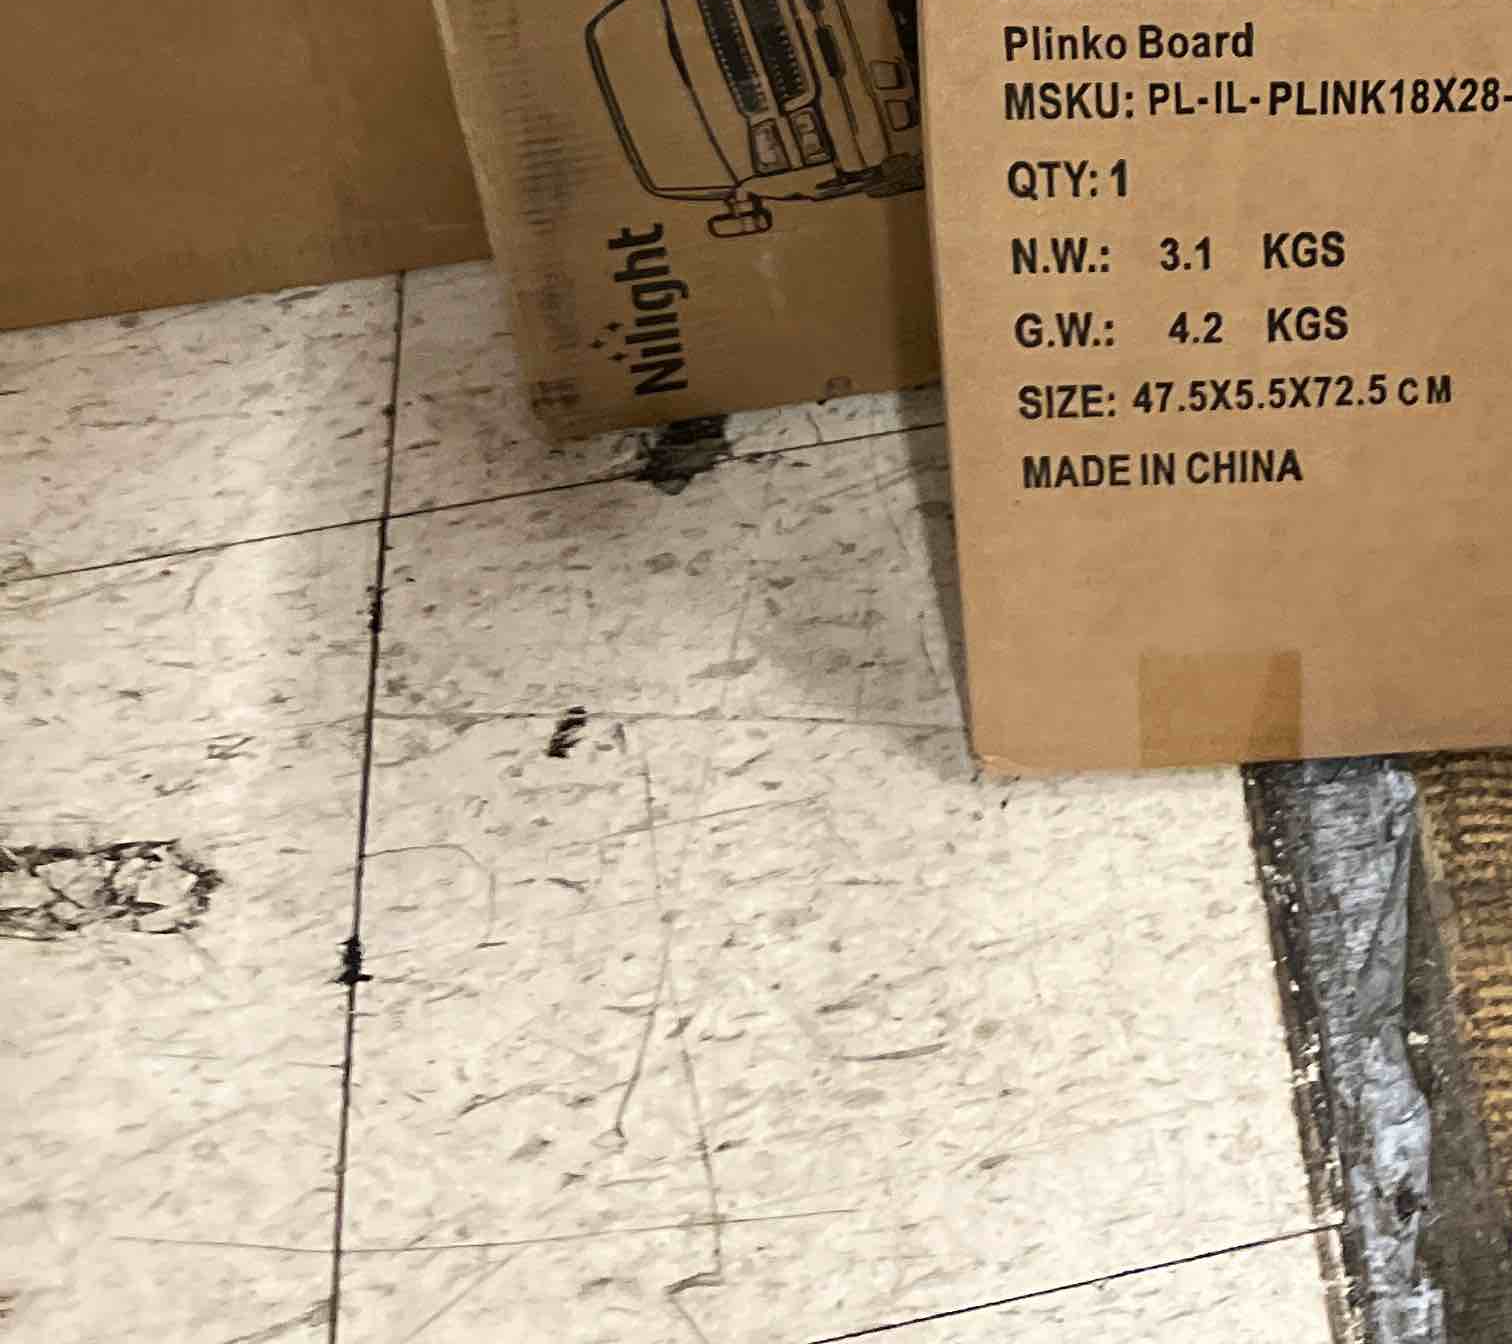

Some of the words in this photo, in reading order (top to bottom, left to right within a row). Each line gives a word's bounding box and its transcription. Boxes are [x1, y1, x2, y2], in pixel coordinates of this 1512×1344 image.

[1004, 25, 1127, 62] Plinko
[1138, 21, 1254, 59] Board
[1004, 81, 1134, 121] MSKU:
[1007, 159, 1098, 201] QTY:
[1110, 158, 1127, 197] 1
[1011, 236, 1109, 275] N.W.:
[1159, 236, 1211, 272] 3.1
[1263, 230, 1345, 270] KGS
[606, 223, 688, 397] Nilight
[1014, 311, 1114, 349] G.W.:
[1168, 311, 1223, 344] 4.2
[1267, 305, 1348, 343] KGS
[1018, 384, 1116, 420] SIZE:
[1132, 374, 1387, 414] 47.5X5.5X72.5
[1022, 454, 1131, 489] MADE
[1140, 452, 1175, 486] IN
[1186, 449, 1303, 484] CHINA
